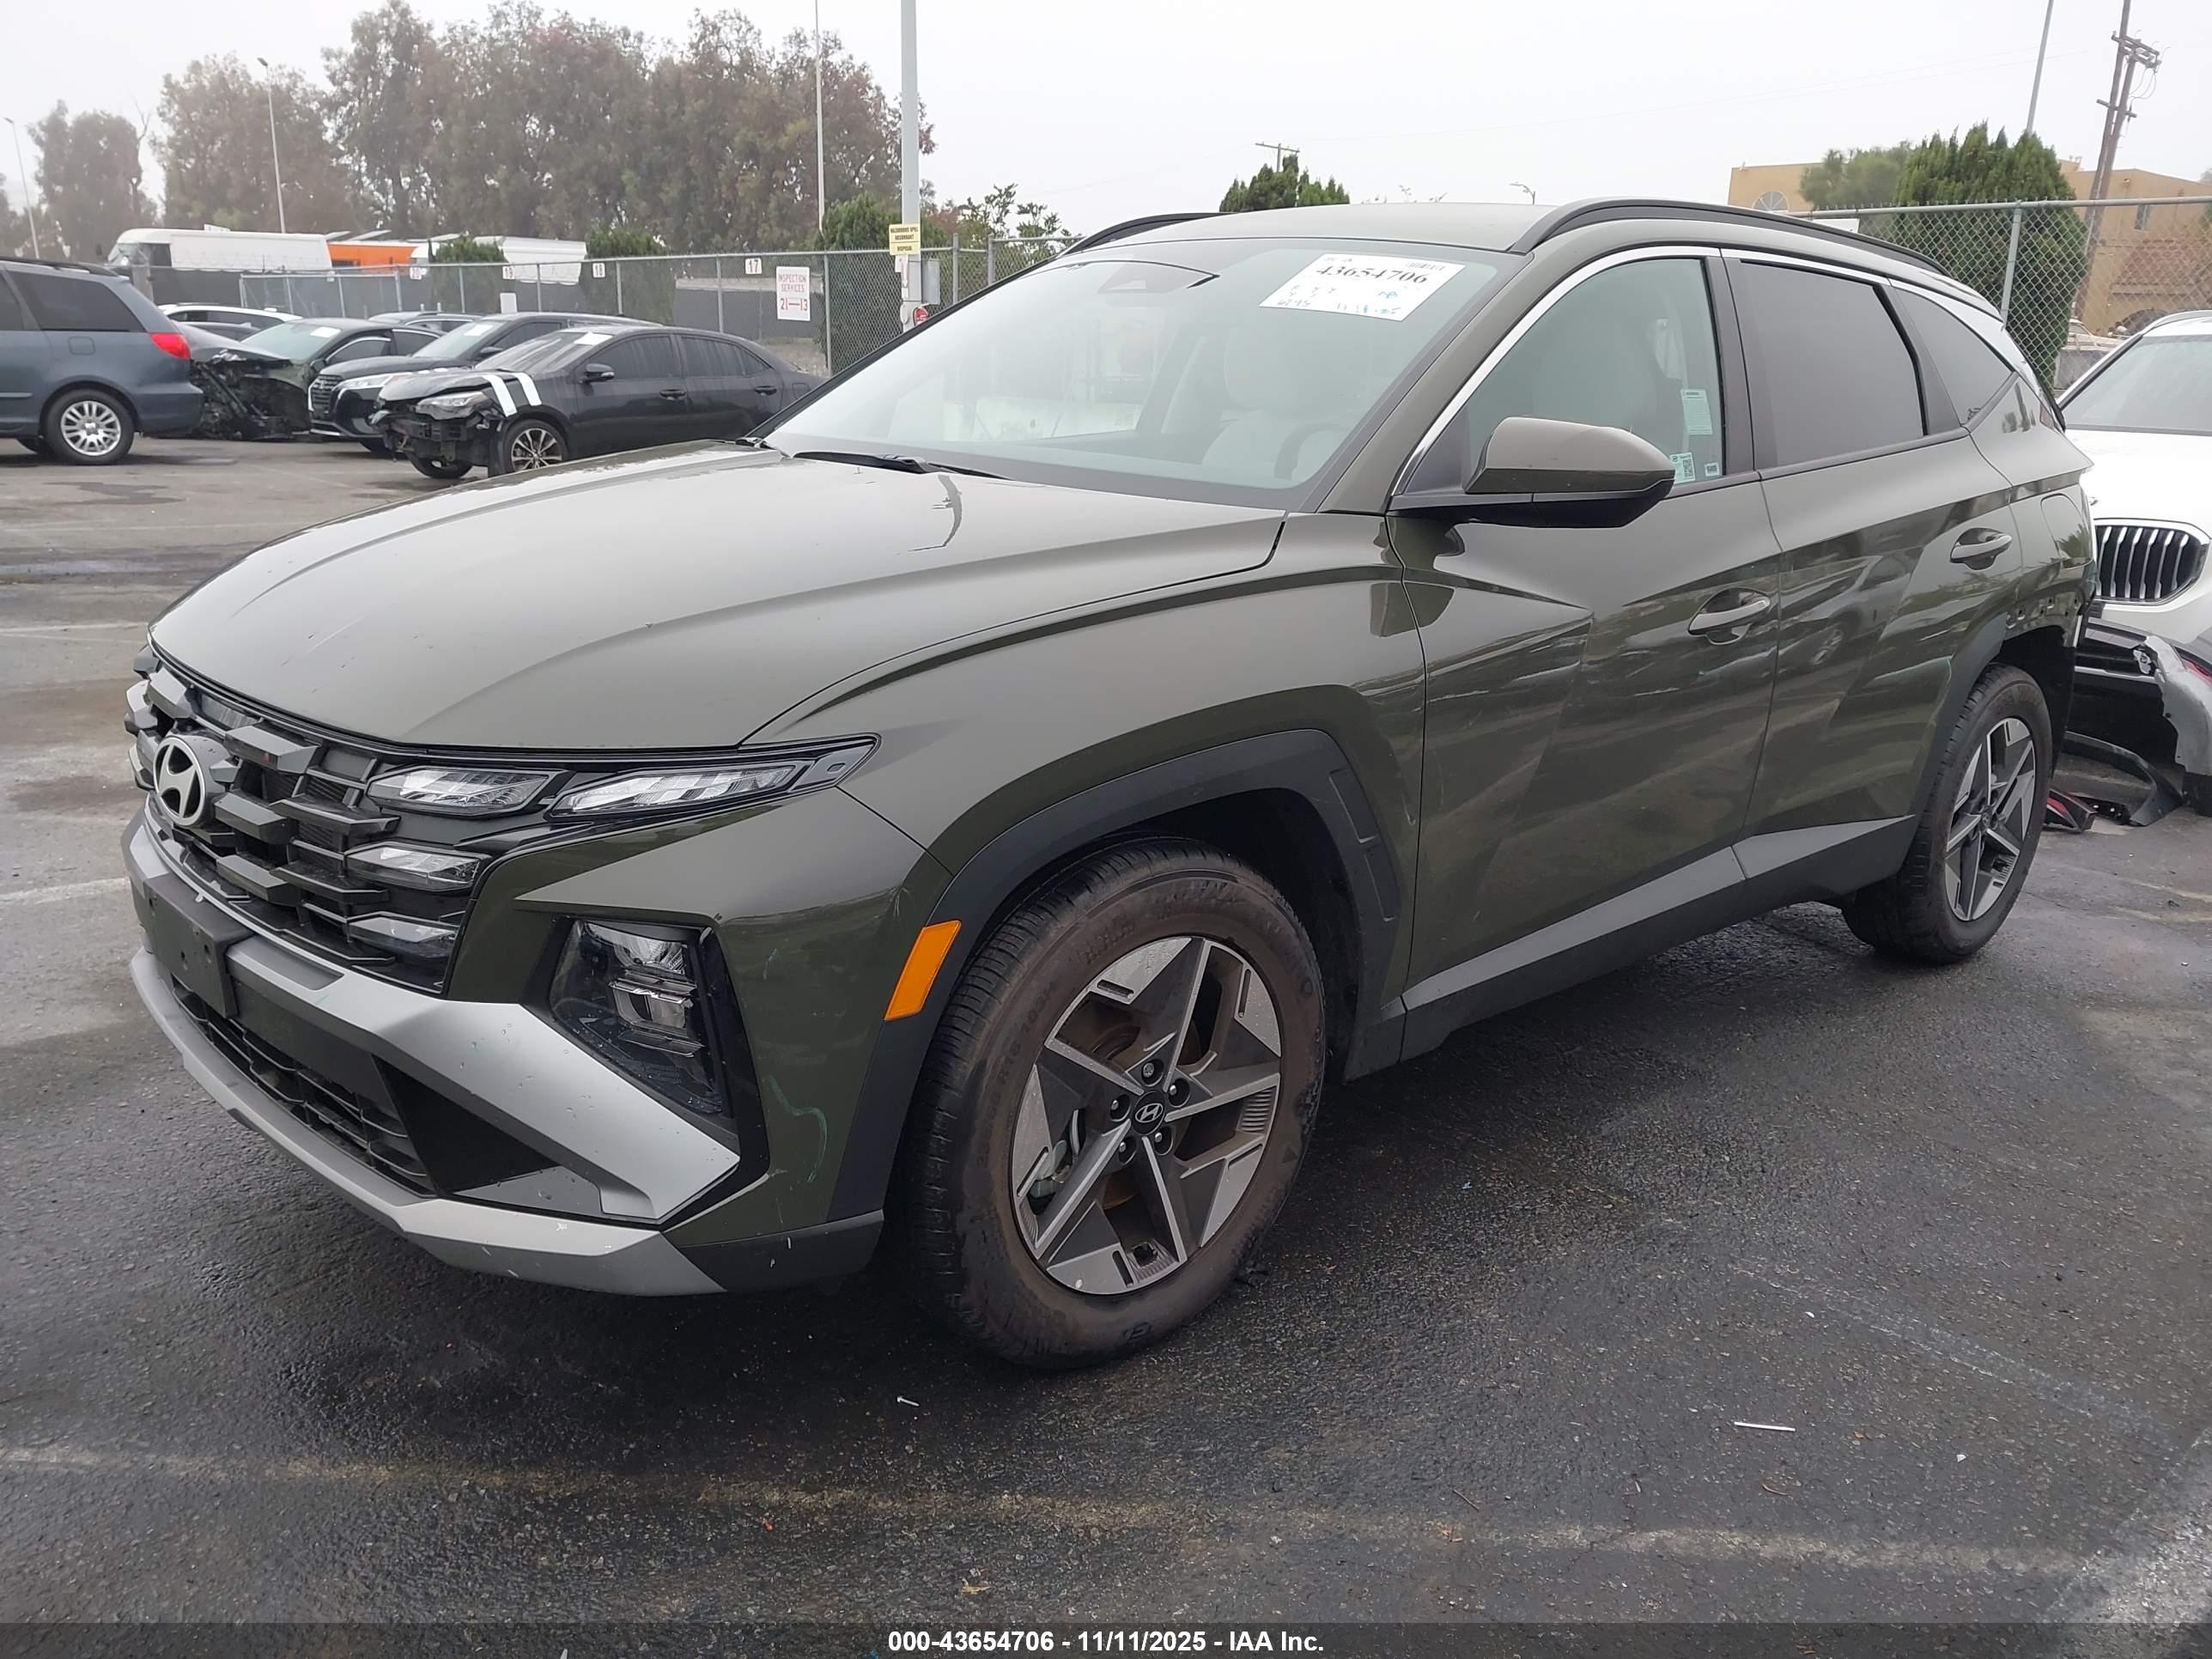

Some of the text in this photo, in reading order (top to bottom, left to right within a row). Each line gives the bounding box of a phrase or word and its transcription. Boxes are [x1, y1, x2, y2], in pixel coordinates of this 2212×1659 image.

[749, 259, 759, 273] 17
[778, 275, 808, 283] INSPECTION
[1316, 264, 1429, 284] 43654706
[781, 283, 805, 293] SERVICES
